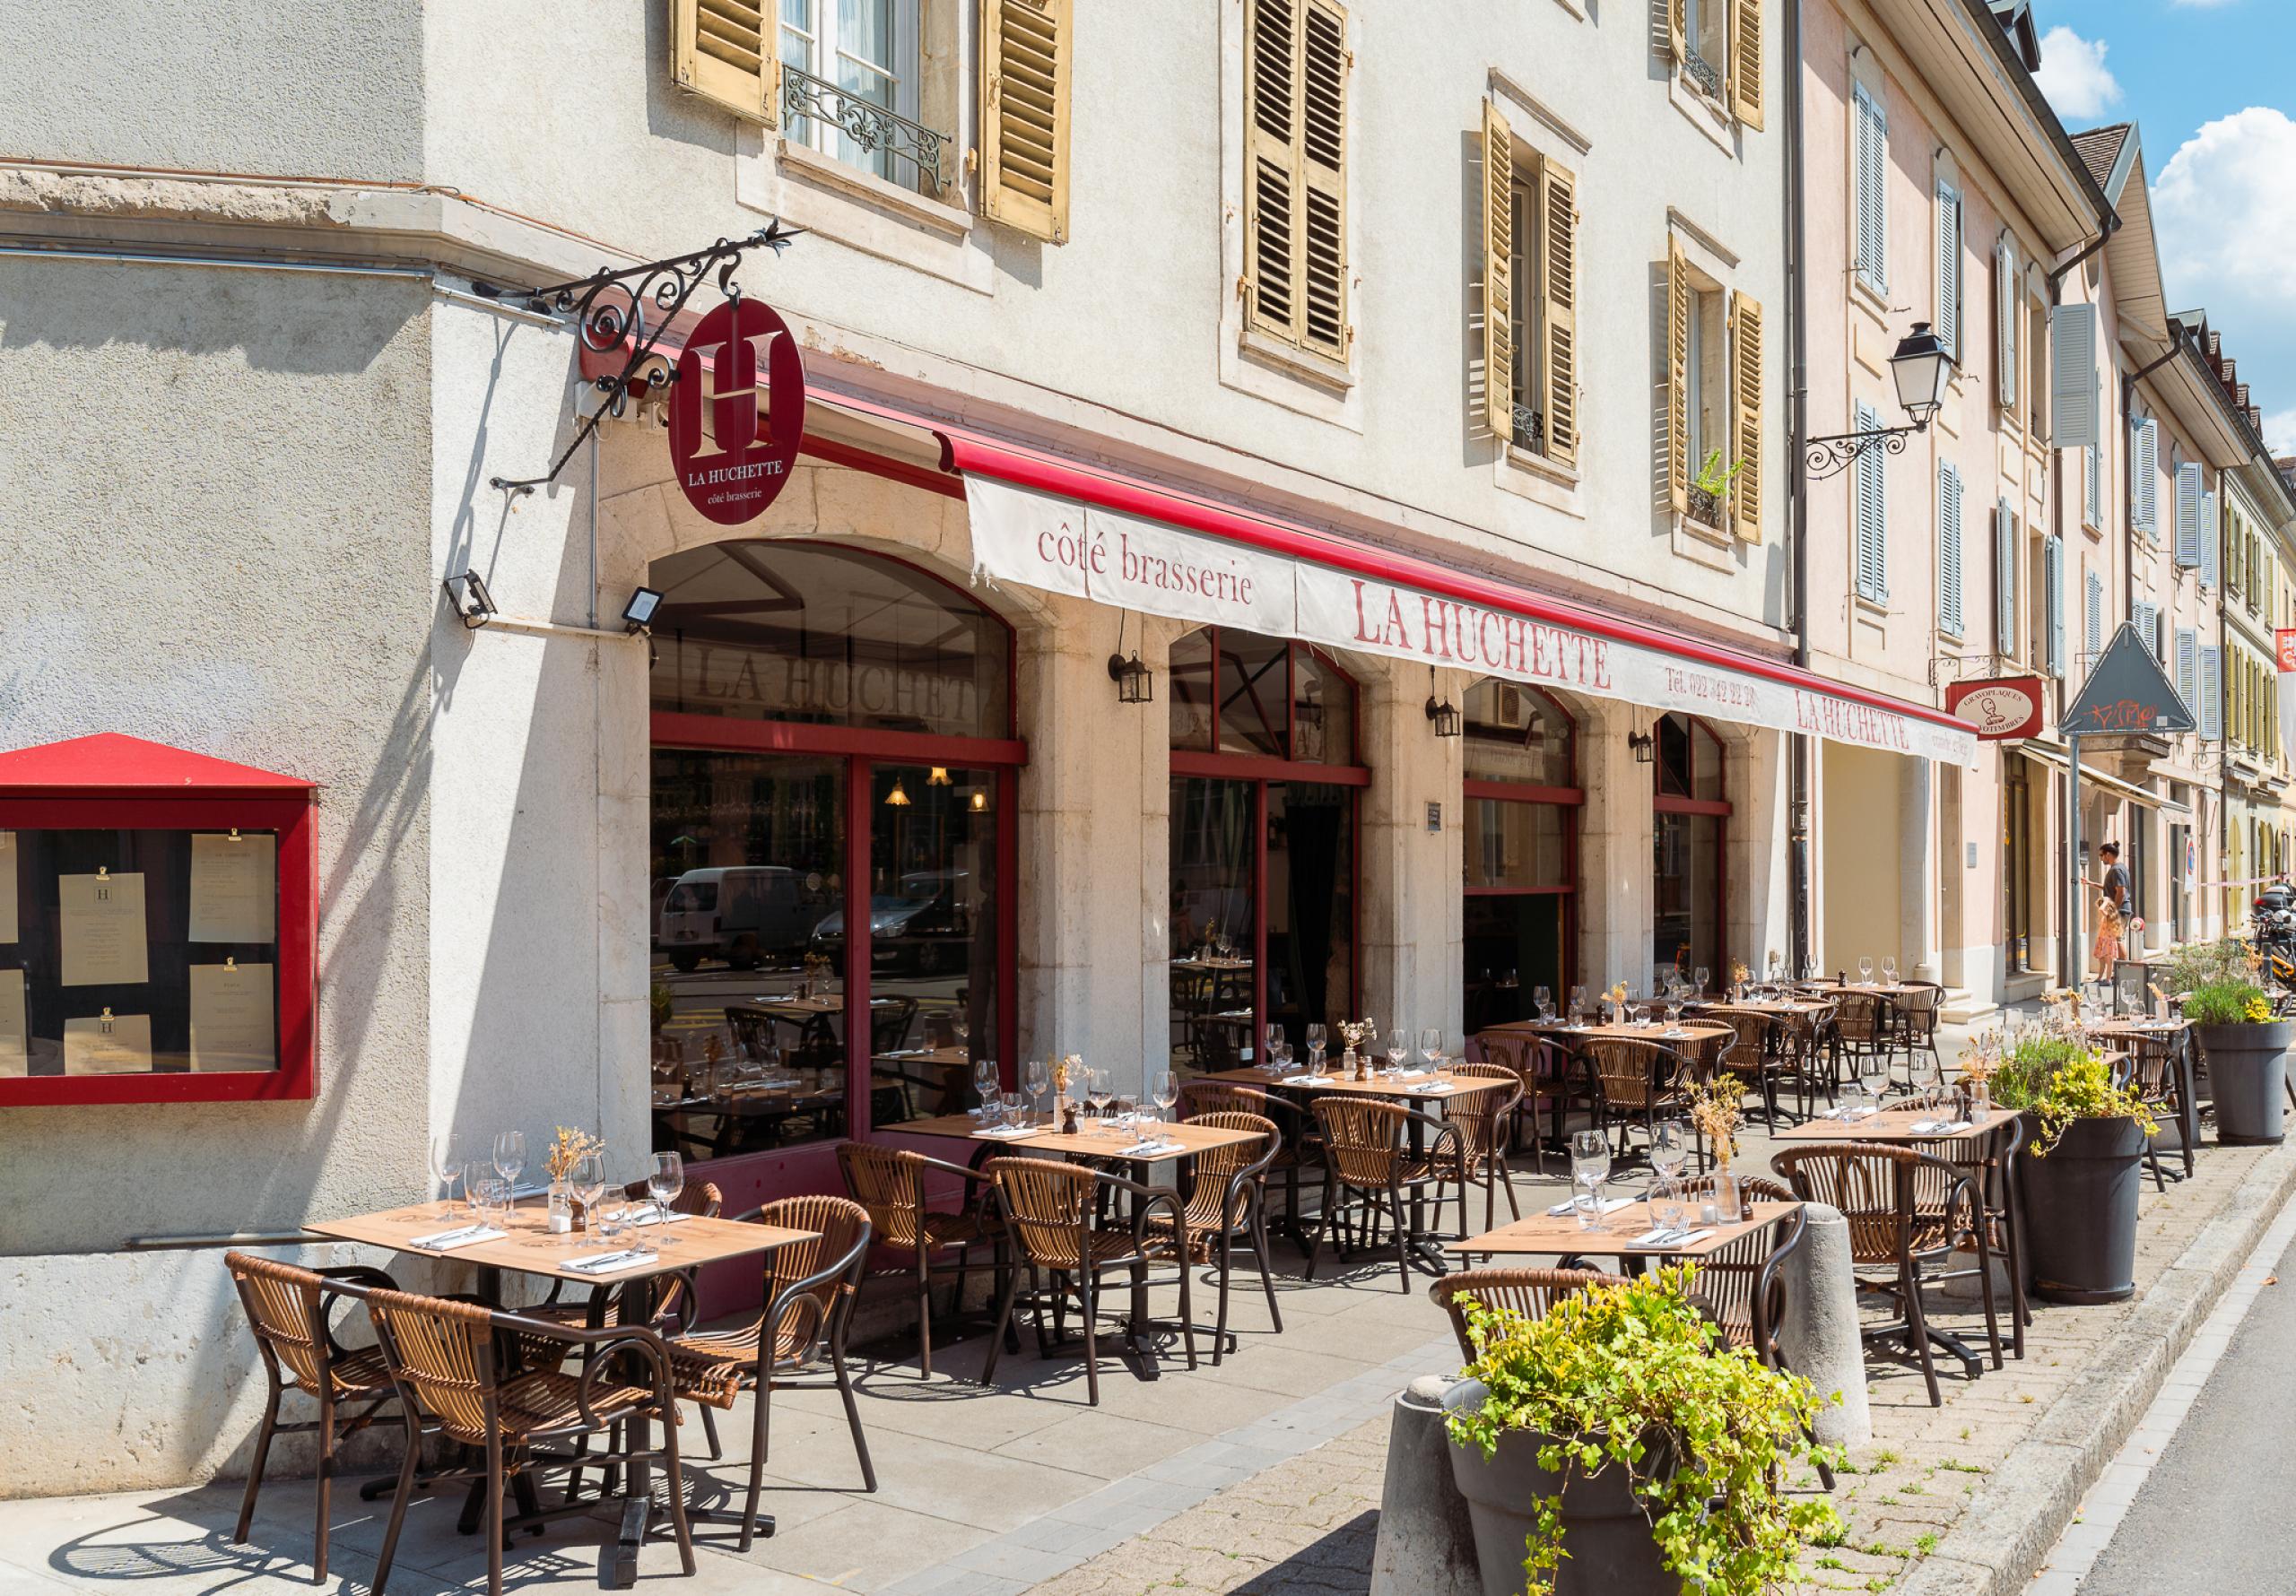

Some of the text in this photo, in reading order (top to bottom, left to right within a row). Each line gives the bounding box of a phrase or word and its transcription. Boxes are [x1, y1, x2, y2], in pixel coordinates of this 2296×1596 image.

[689, 460, 783, 487] LA HUCHETTE
[708, 487, 762, 505] côté brasserie
[1038, 523, 1253, 605] côté brasserie
[1351, 579, 1612, 690] LA HUCHETTE
[1665, 667, 1687, 694] Tél.
[1963, 690, 2023, 707] GRAVOPLAQUES
[1795, 690, 1821, 731] LA
[1822, 697, 1909, 750] HUCHETTE
